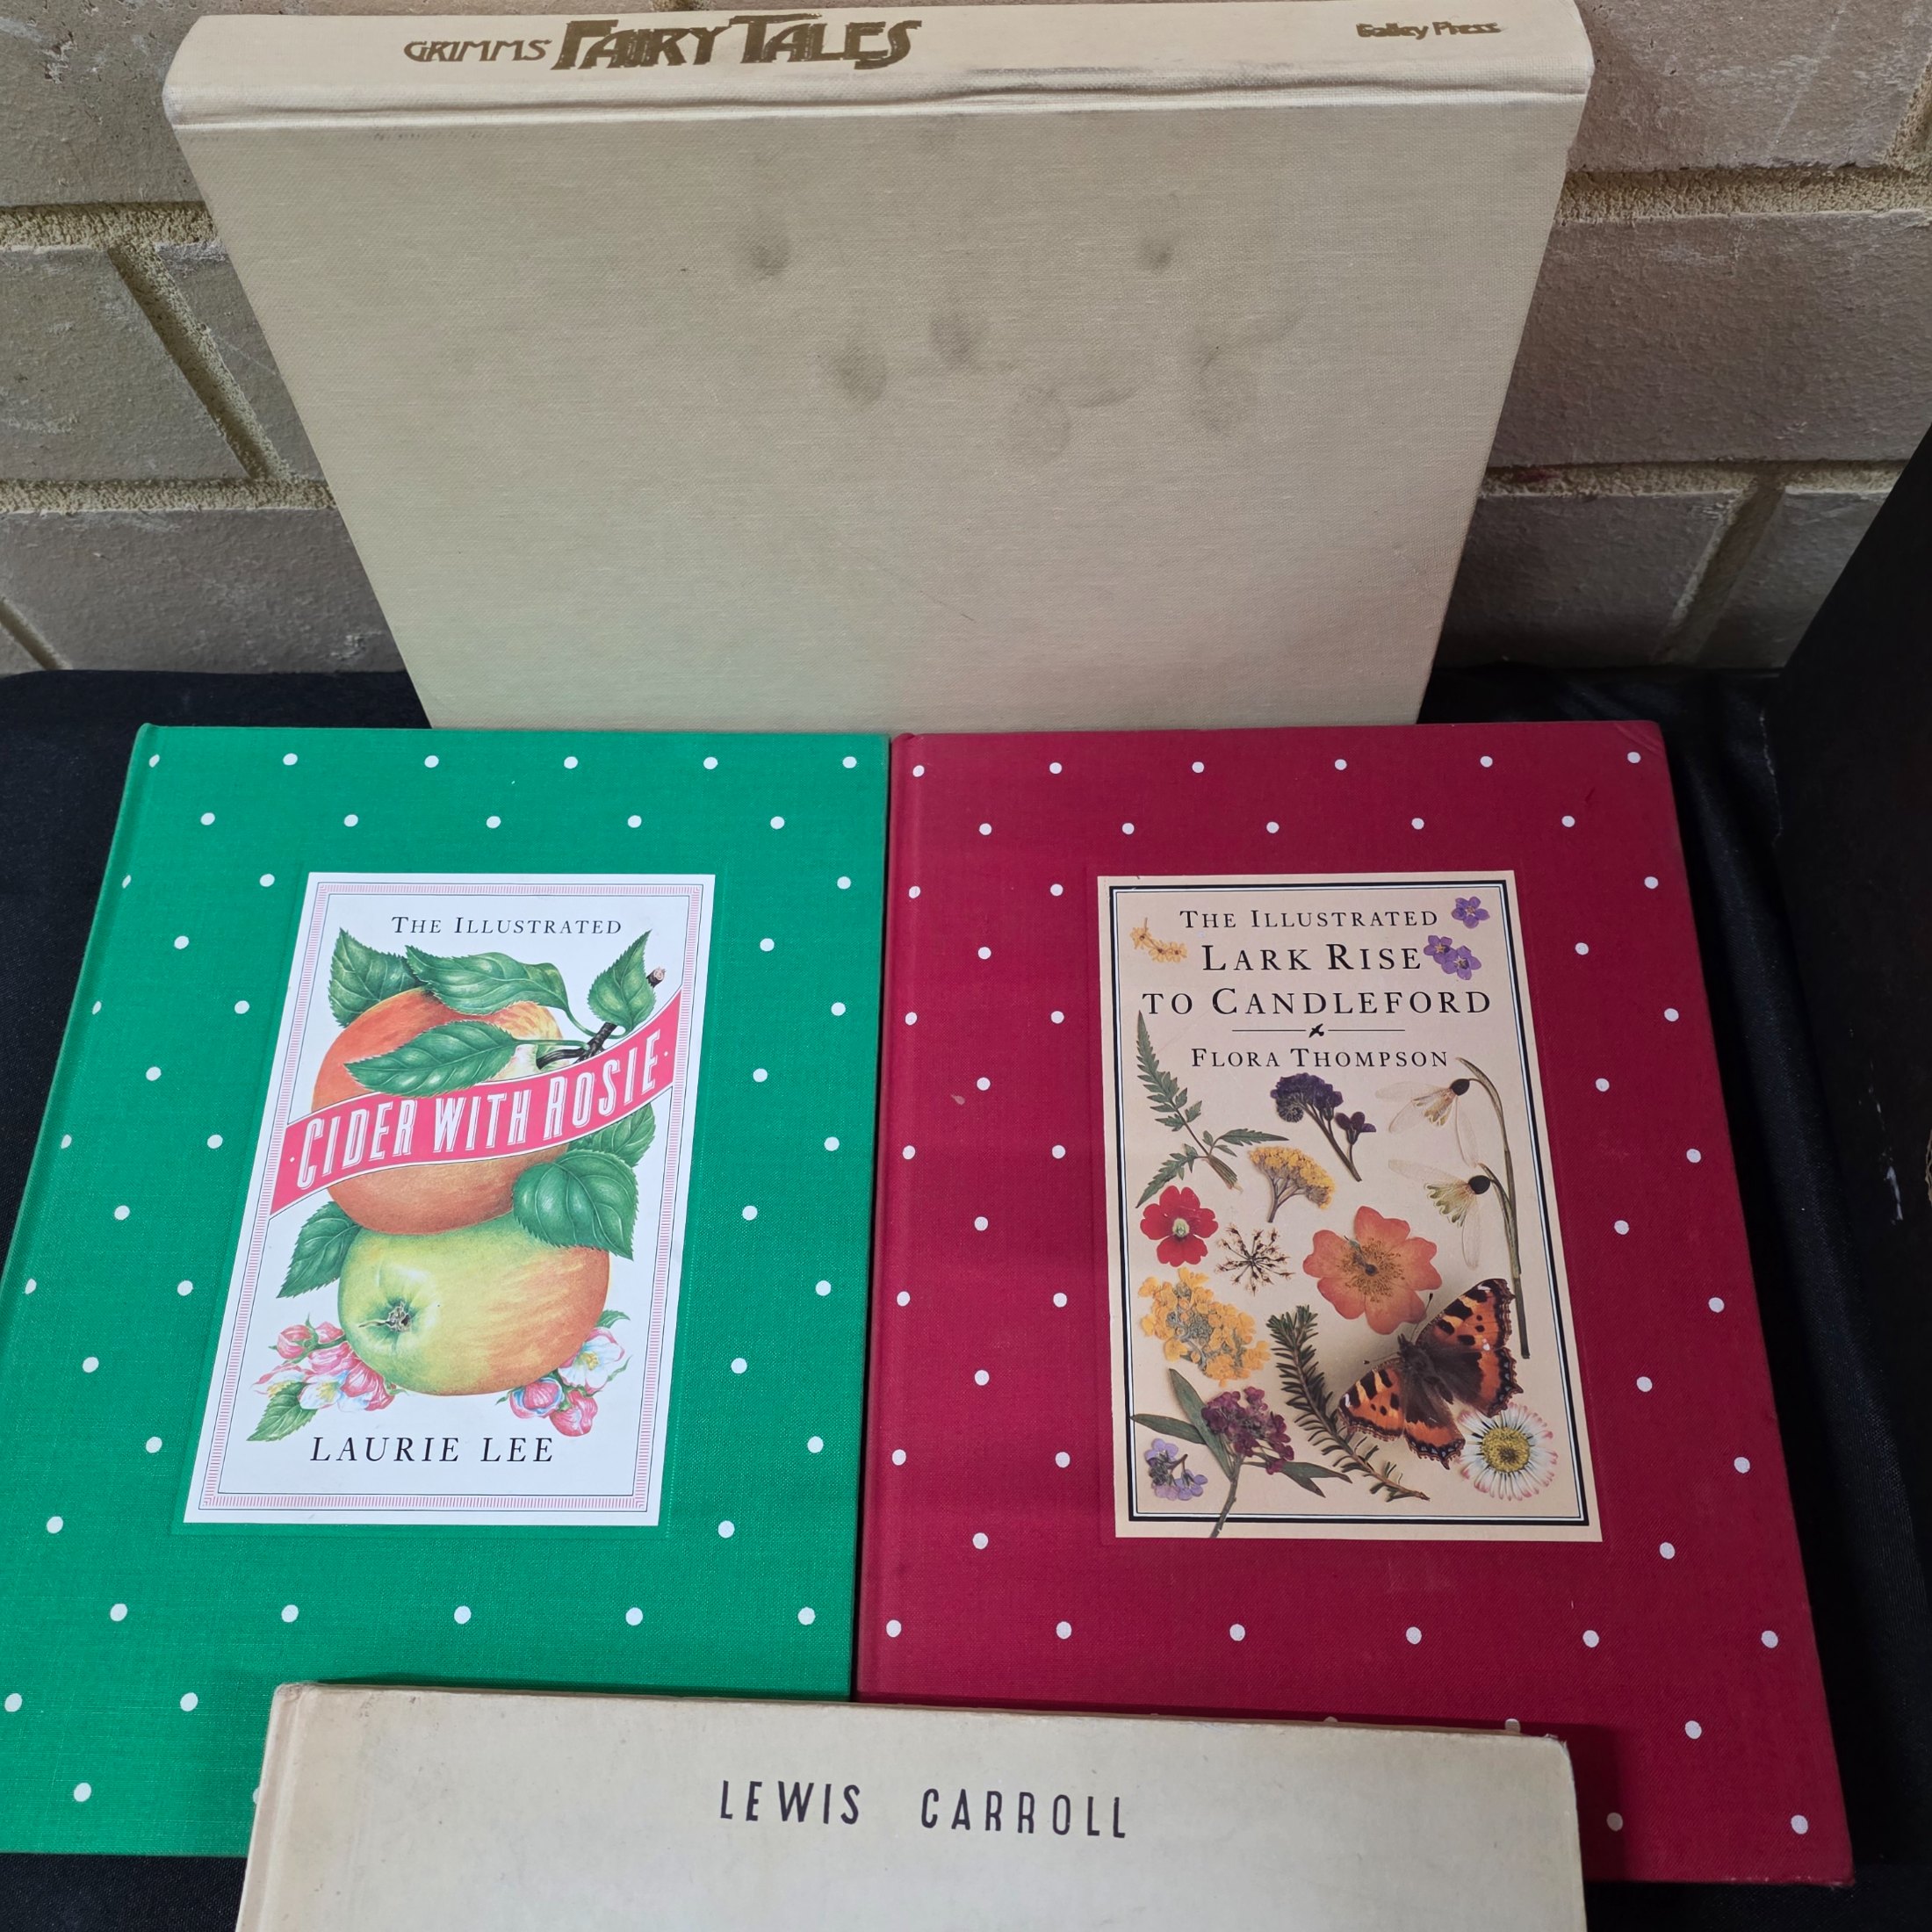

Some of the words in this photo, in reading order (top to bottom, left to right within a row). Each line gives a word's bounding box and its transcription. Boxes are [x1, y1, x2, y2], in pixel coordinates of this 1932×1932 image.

[403, 39, 551, 62] GRIMMS
[551, 18, 732, 70] FAIRY
[729, 12, 923, 70] TALES
[391, 915, 442, 934] THE
[453, 915, 623, 934] ILLUSTRATED
[1179, 910, 1236, 928] THE
[1251, 909, 1438, 928] ILLUSTRATED
[1200, 943, 1312, 971] LARK
[1325, 942, 1422, 971] RISE
[1142, 992, 1193, 1015] TO
[1211, 987, 1491, 1015] CANDLEFORD
[1191, 1048, 1280, 1068] FLORA
[1290, 1047, 1448, 1068] THOMPSON
[296, 1098, 418, 1190] CIDER
[432, 1088, 532, 1154] WITH
[542, 1028, 661, 1143] ROSIE
[310, 1436, 460, 1462] LAURIE
[480, 1437, 554, 1463] LEE
[719, 1779, 861, 1825] LEWIS
[920, 1787, 1127, 1839] CARROLL
